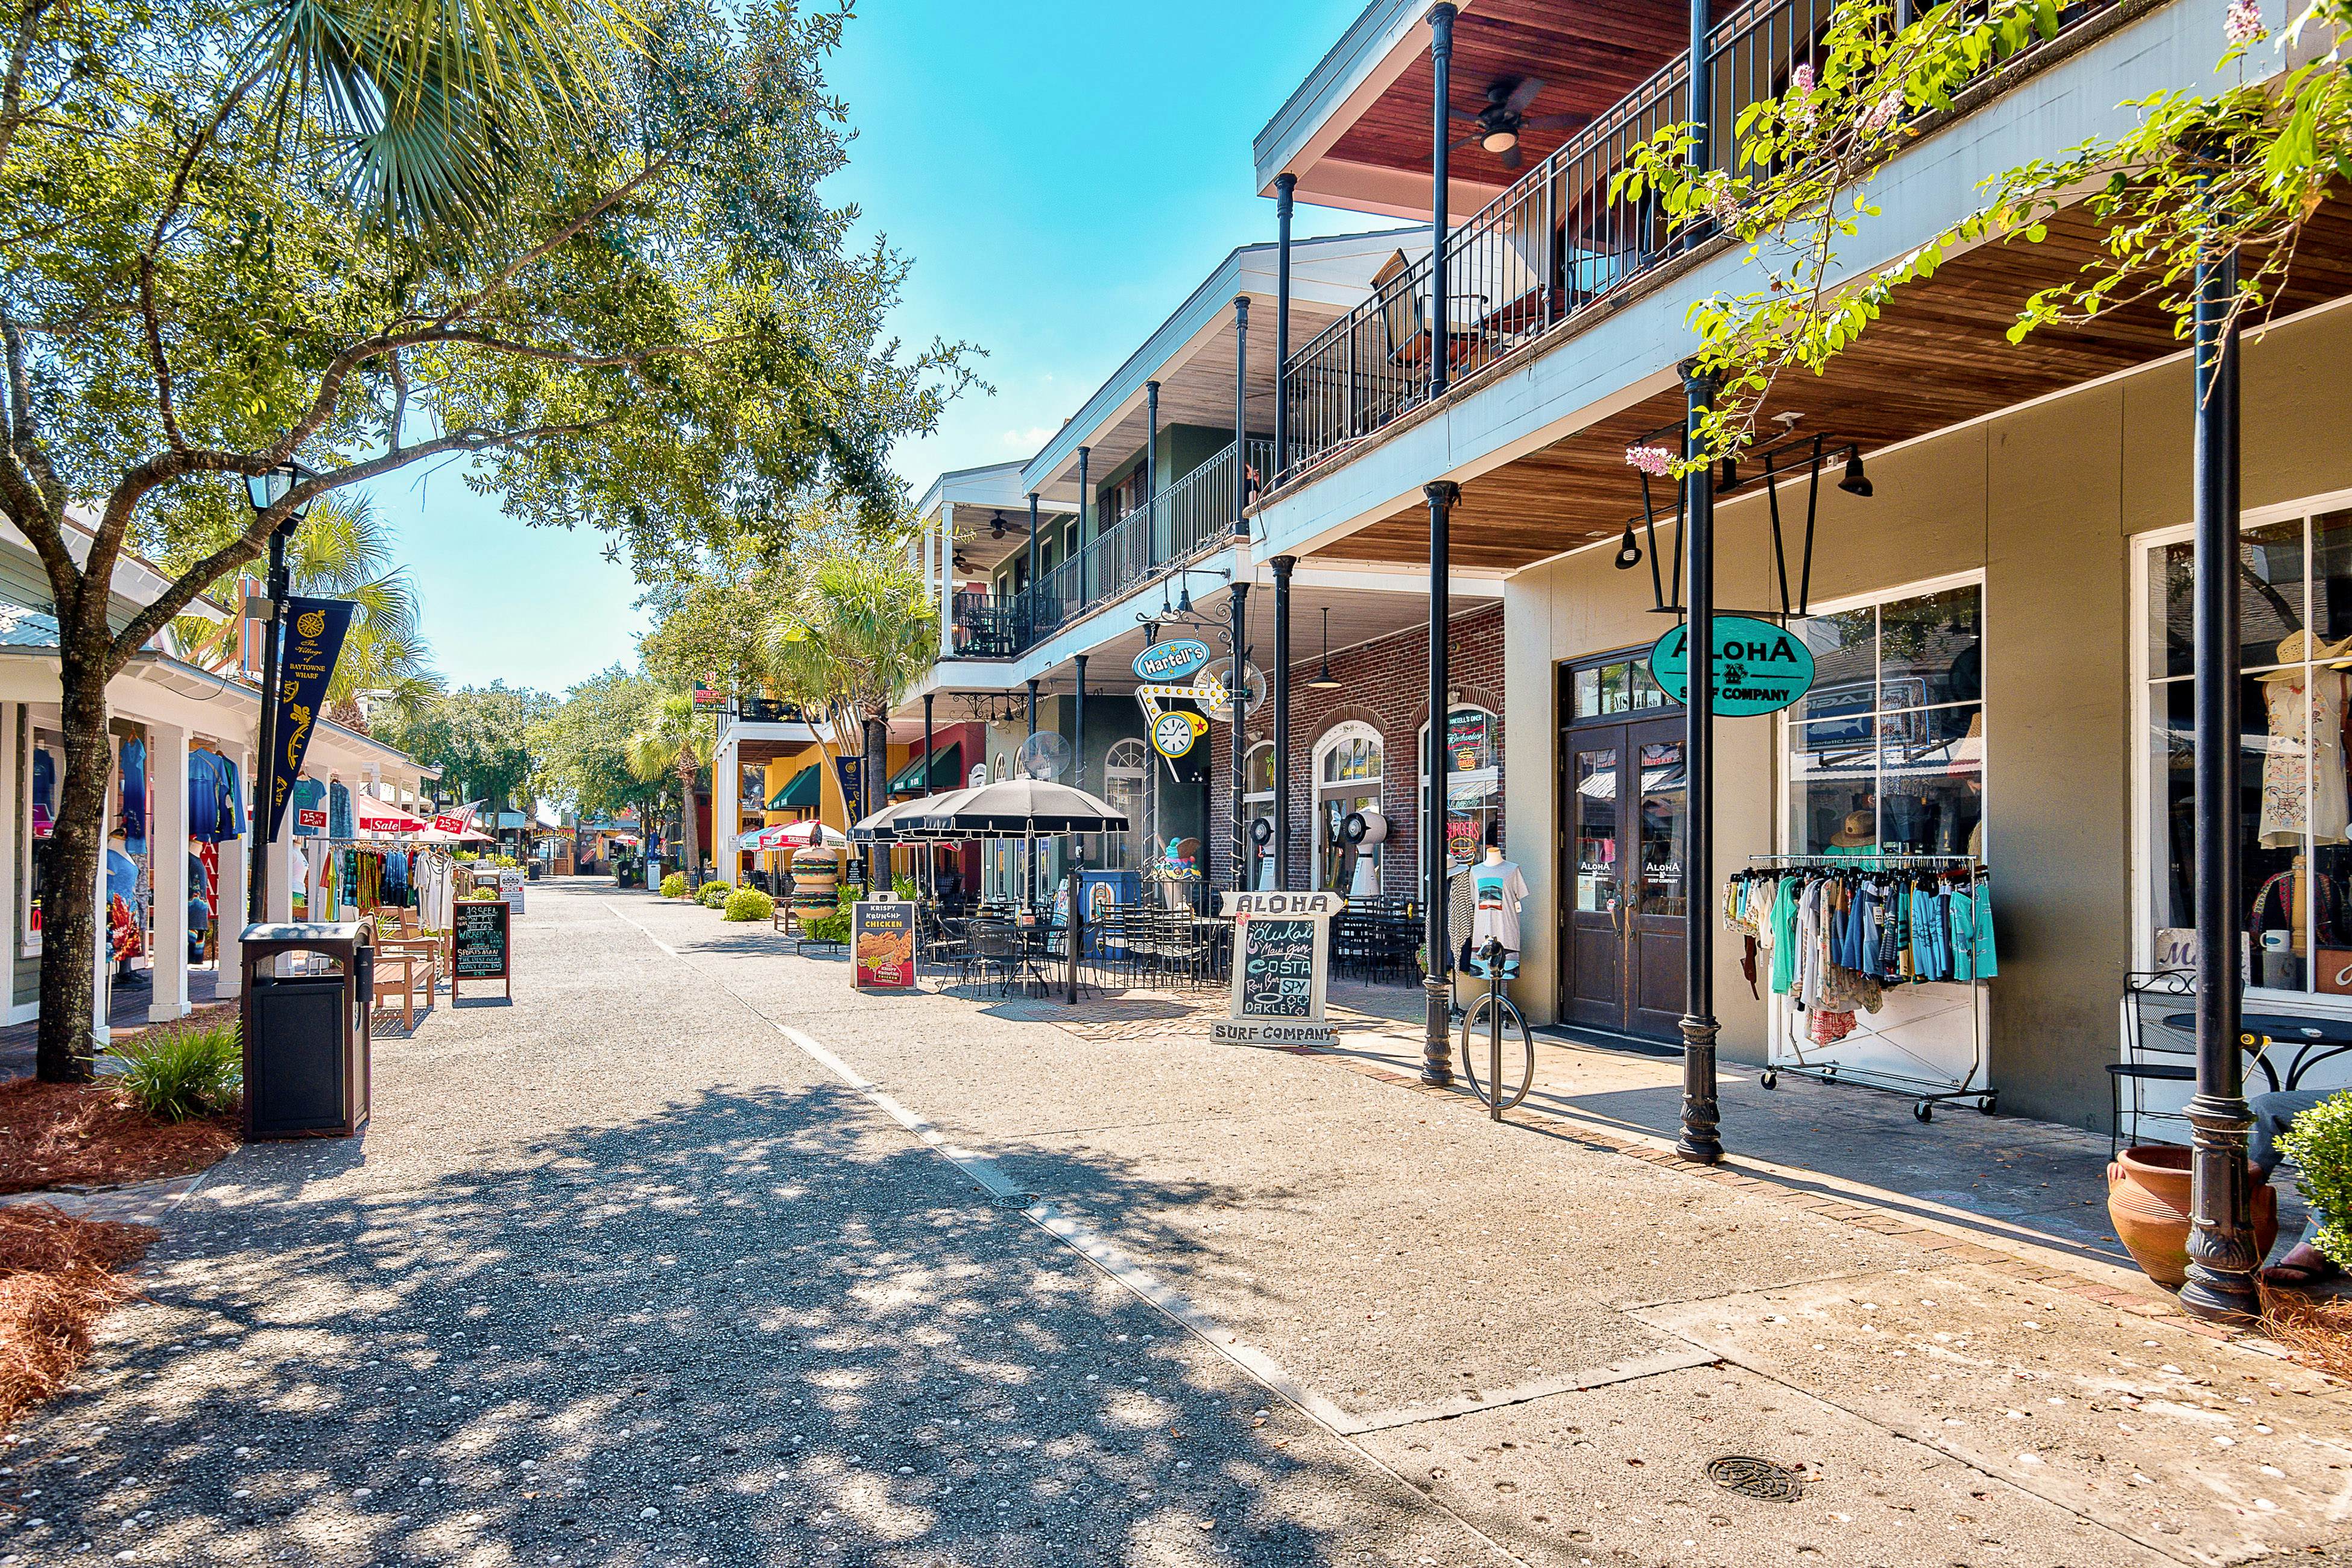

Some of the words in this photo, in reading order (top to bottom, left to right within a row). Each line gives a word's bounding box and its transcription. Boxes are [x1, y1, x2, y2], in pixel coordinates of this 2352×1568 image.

[295, 646, 322, 656] Village
[289, 663, 326, 671] BAYTOWNE
[1143, 647, 1204, 675] Hartell's
[1680, 686, 1719, 698] SF
[1722, 688, 1790, 701] COMPANY
[302, 812, 323, 823] 25%
[438, 818, 460, 828] 25%
[372, 820, 399, 831] Sale
[1447, 821, 1480, 841] BURGERS
[1581, 862, 1611, 871] ALOHA
[1646, 862, 1680, 872] ALOHA
[1236, 895, 1327, 913] ALOHA
[1261, 943, 1283, 955] Maui
[1248, 959, 1311, 975] COSTA
[1282, 980, 1306, 994] SPY
[1245, 1002, 1296, 1014] OAKLEY
[1215, 1025, 1259, 1040] SURF
[1263, 1026, 1335, 1042] COMPANY
